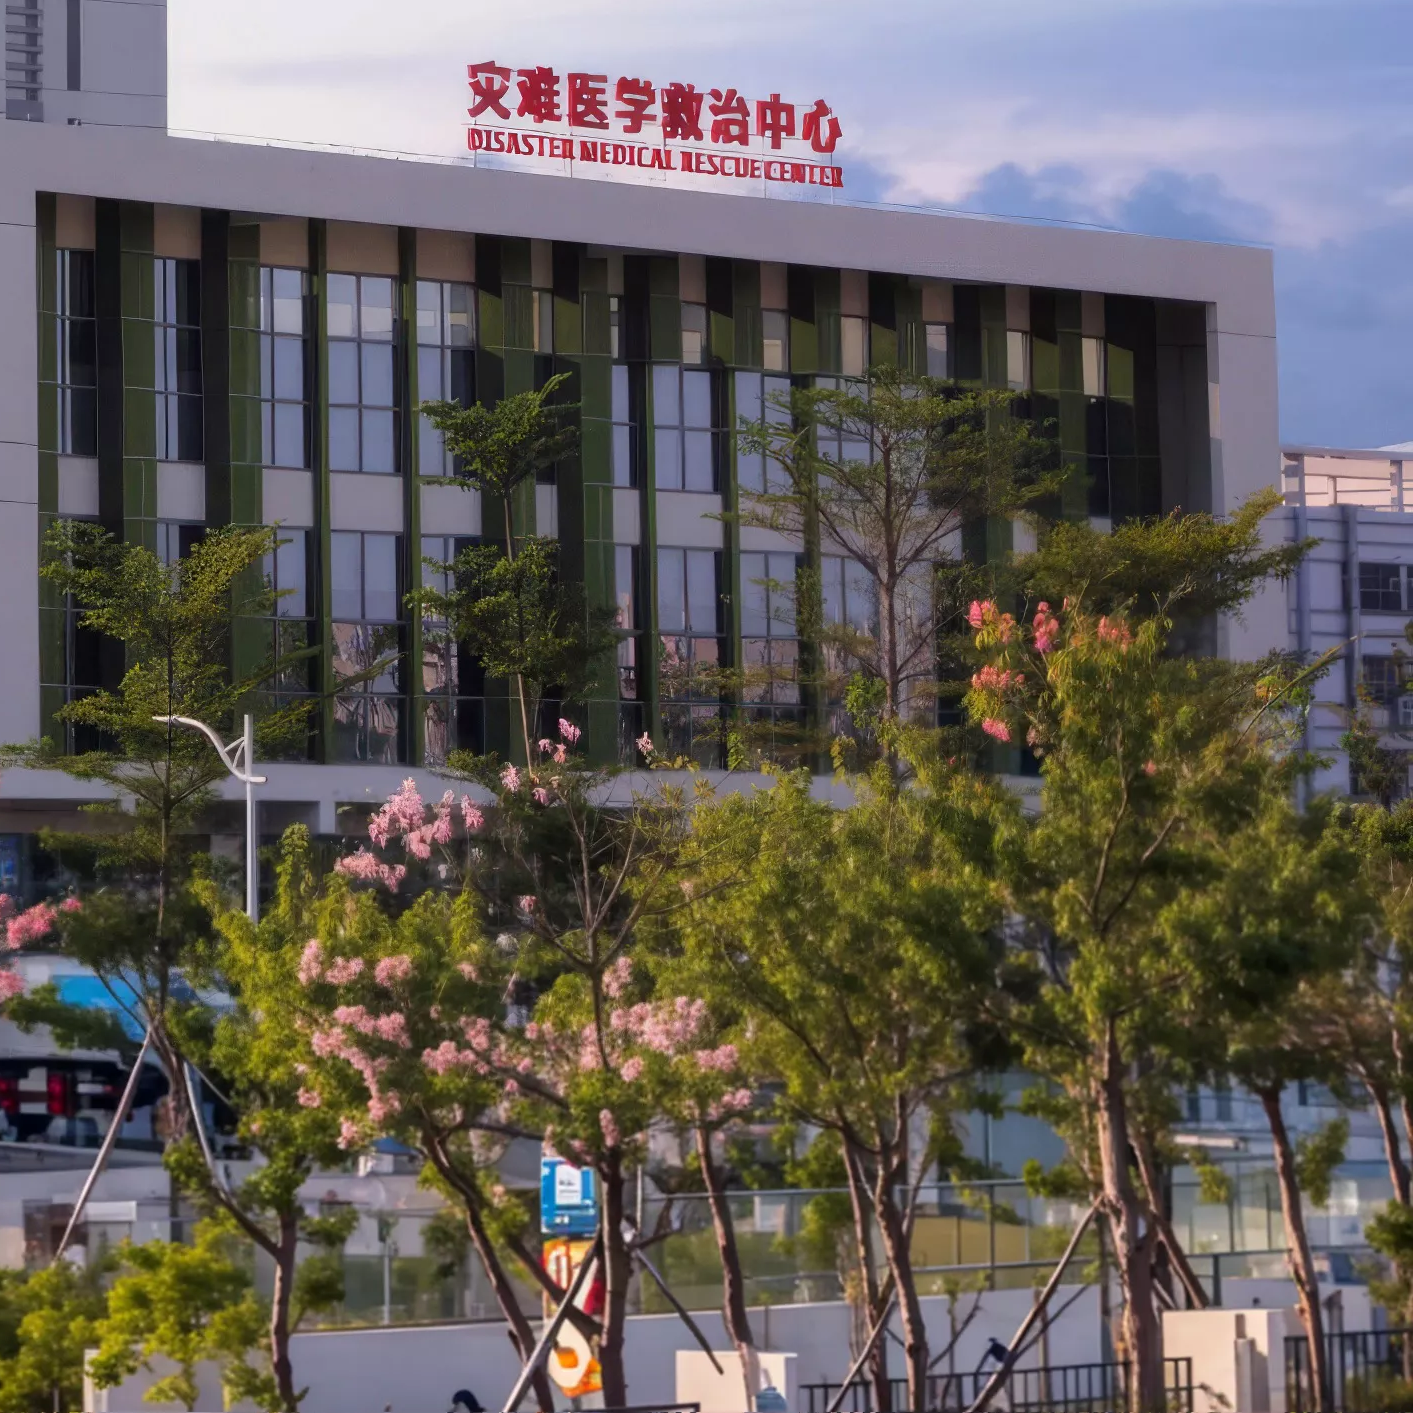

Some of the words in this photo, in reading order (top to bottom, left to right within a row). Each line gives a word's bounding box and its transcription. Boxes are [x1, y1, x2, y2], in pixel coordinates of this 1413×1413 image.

[467, 61, 843, 153] 灾难医学救治中心
[467, 128, 575, 160] DISASTER
[580, 140, 677, 170] MEDICAL
[681, 151, 761, 179] RESCUE
